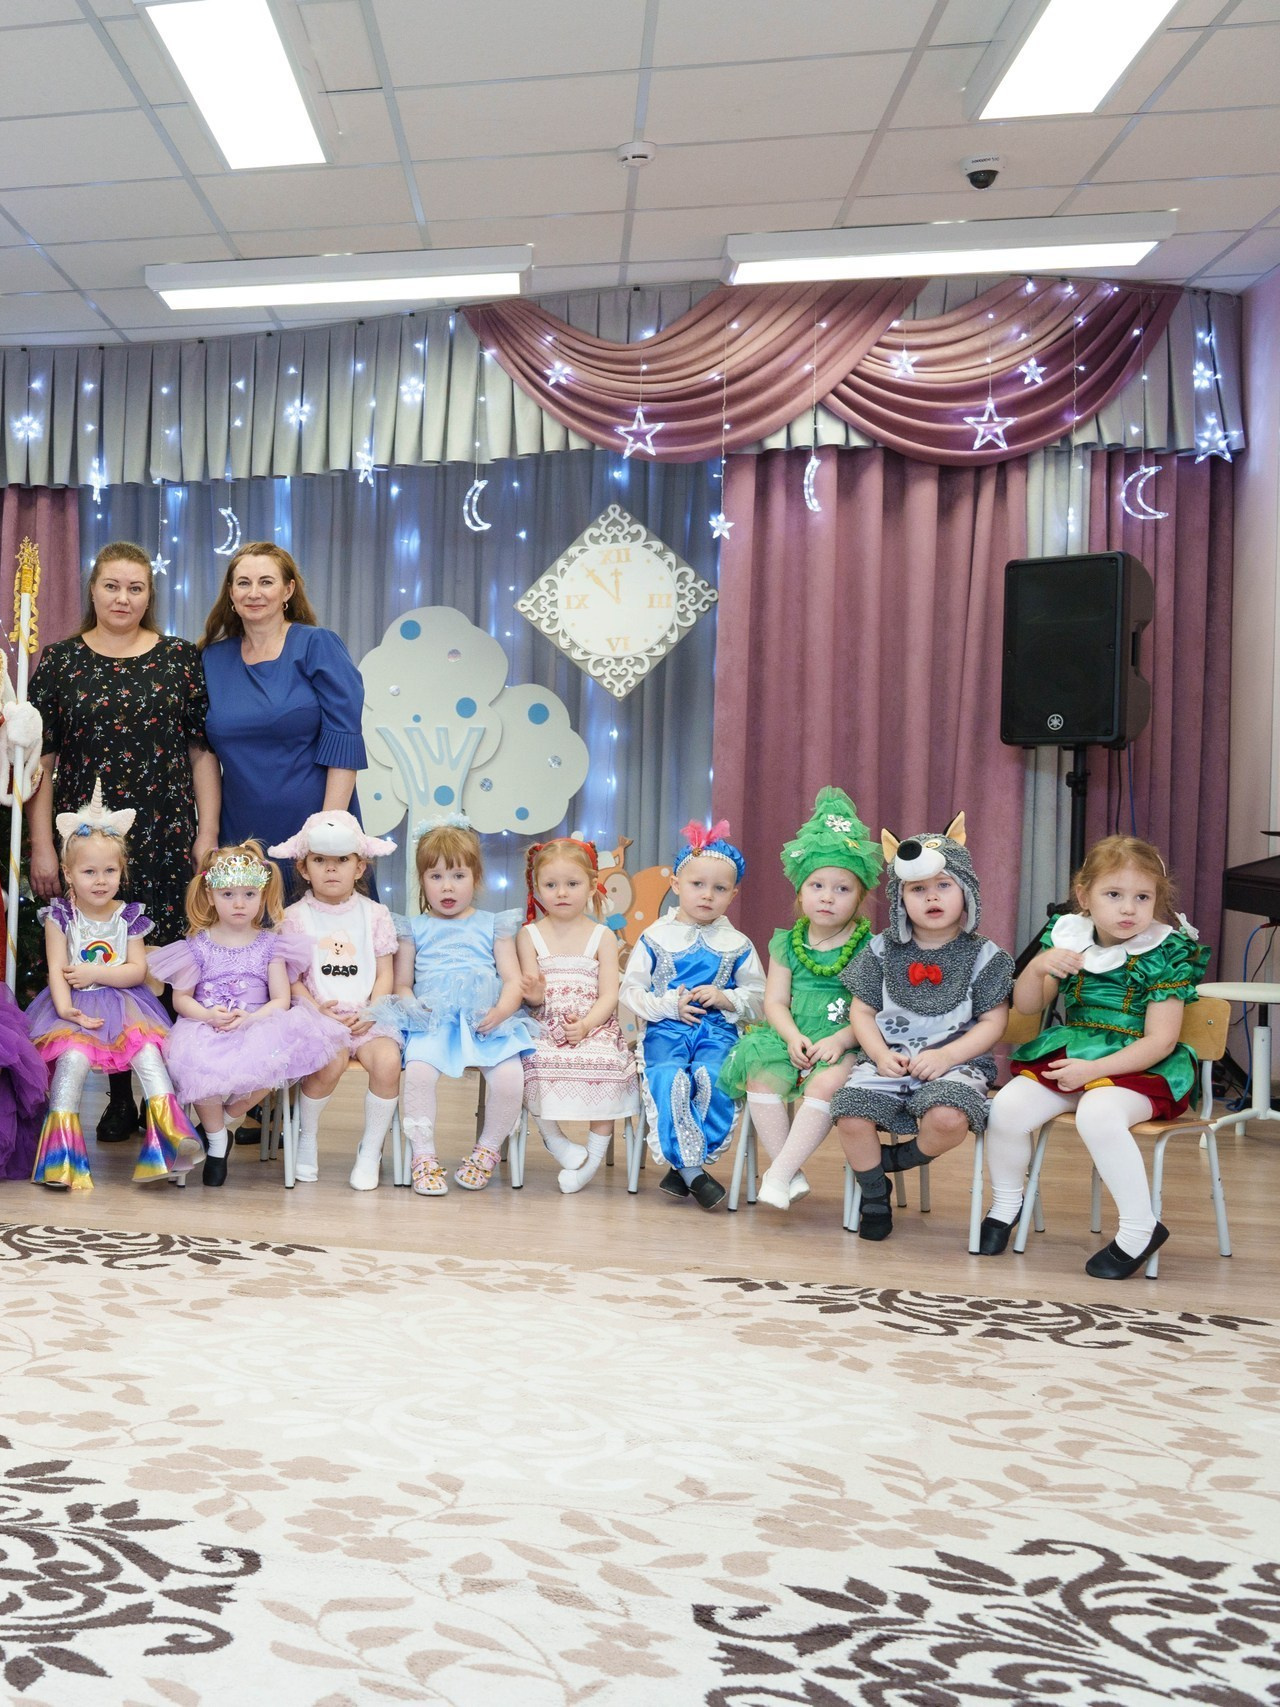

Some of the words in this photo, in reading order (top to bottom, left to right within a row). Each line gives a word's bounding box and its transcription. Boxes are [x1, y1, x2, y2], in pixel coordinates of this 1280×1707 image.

[597, 547, 632, 565] XII
[565, 594, 589, 609] IX
[647, 593, 673, 609] III
[605, 636, 631, 654] VI
